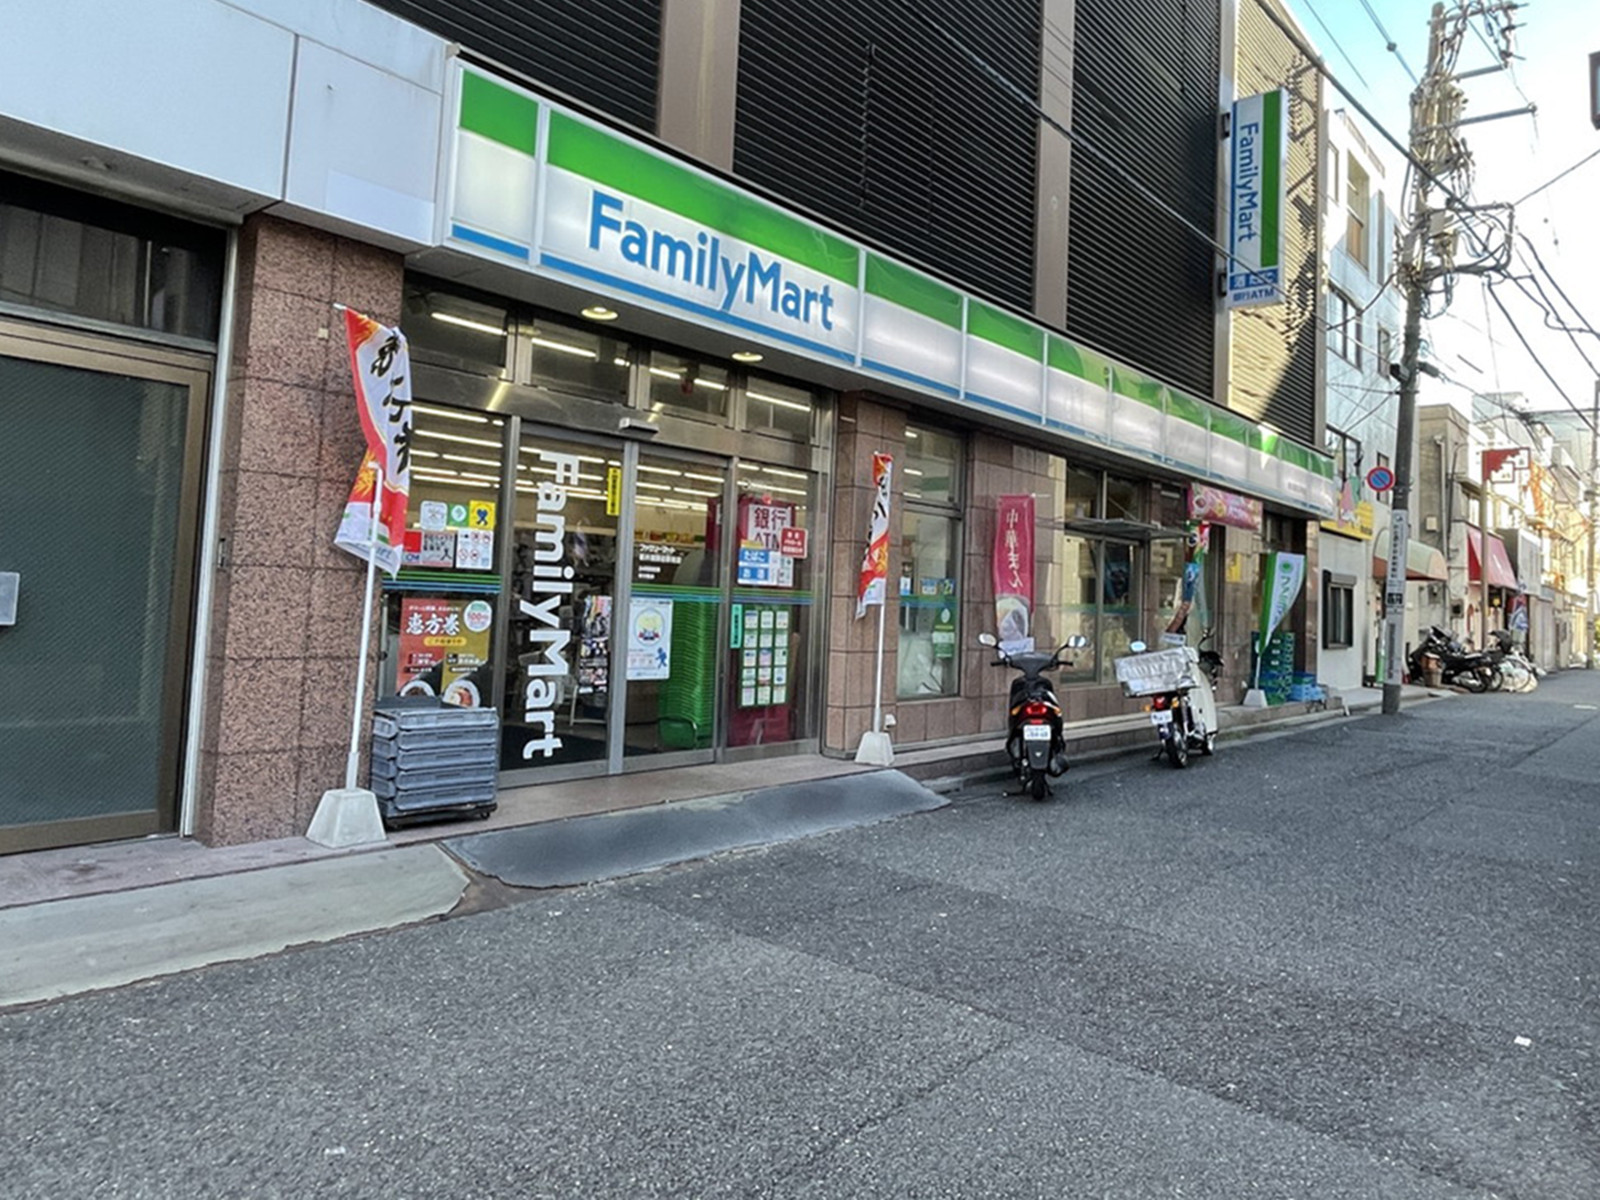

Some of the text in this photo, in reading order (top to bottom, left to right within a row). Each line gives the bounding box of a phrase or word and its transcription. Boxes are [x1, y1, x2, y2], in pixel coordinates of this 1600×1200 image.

[1237, 122, 1259, 243] FamilyMart
[588, 189, 834, 331] FamilyMart
[754, 507, 787, 531] 銀行
[406, 612, 460, 635] 恵方巻
[519, 450, 580, 759] FamilyMart
